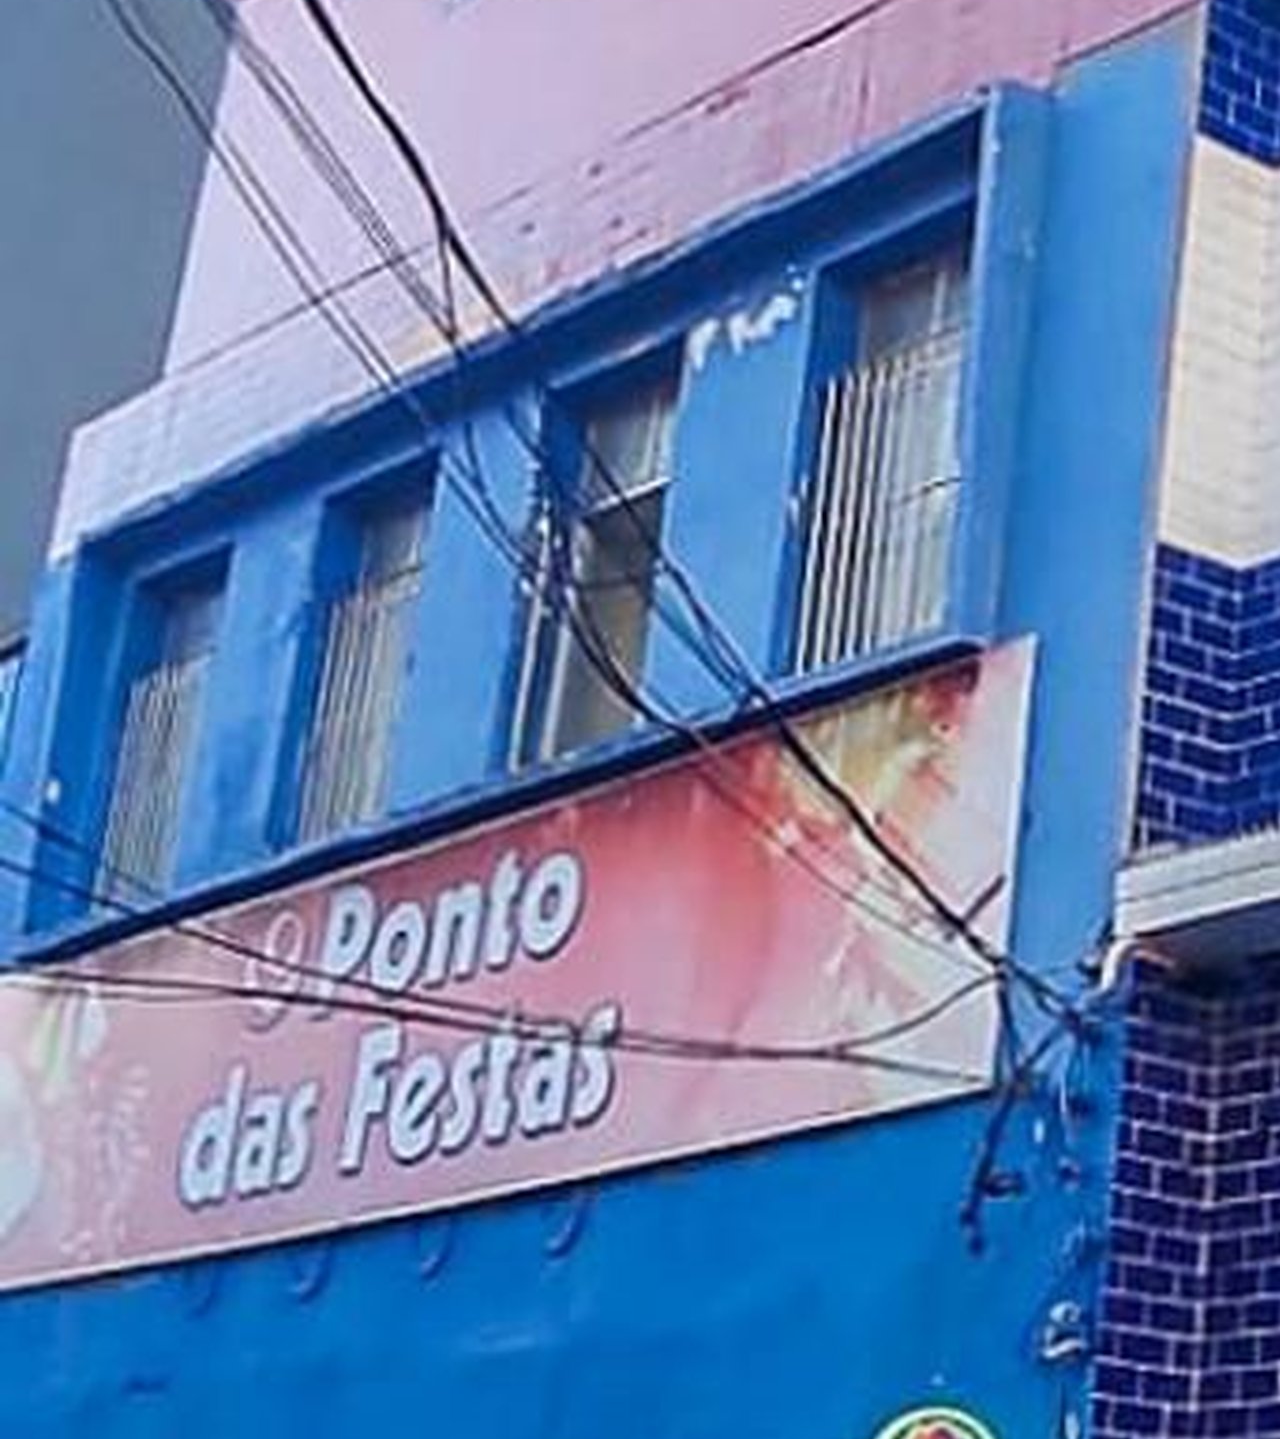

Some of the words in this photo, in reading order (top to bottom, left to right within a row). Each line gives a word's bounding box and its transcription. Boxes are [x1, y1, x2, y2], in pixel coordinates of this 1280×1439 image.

[312, 850, 584, 1019] Ponto
[179, 1064, 318, 1208] das
[338, 1004, 622, 1176] Festas
